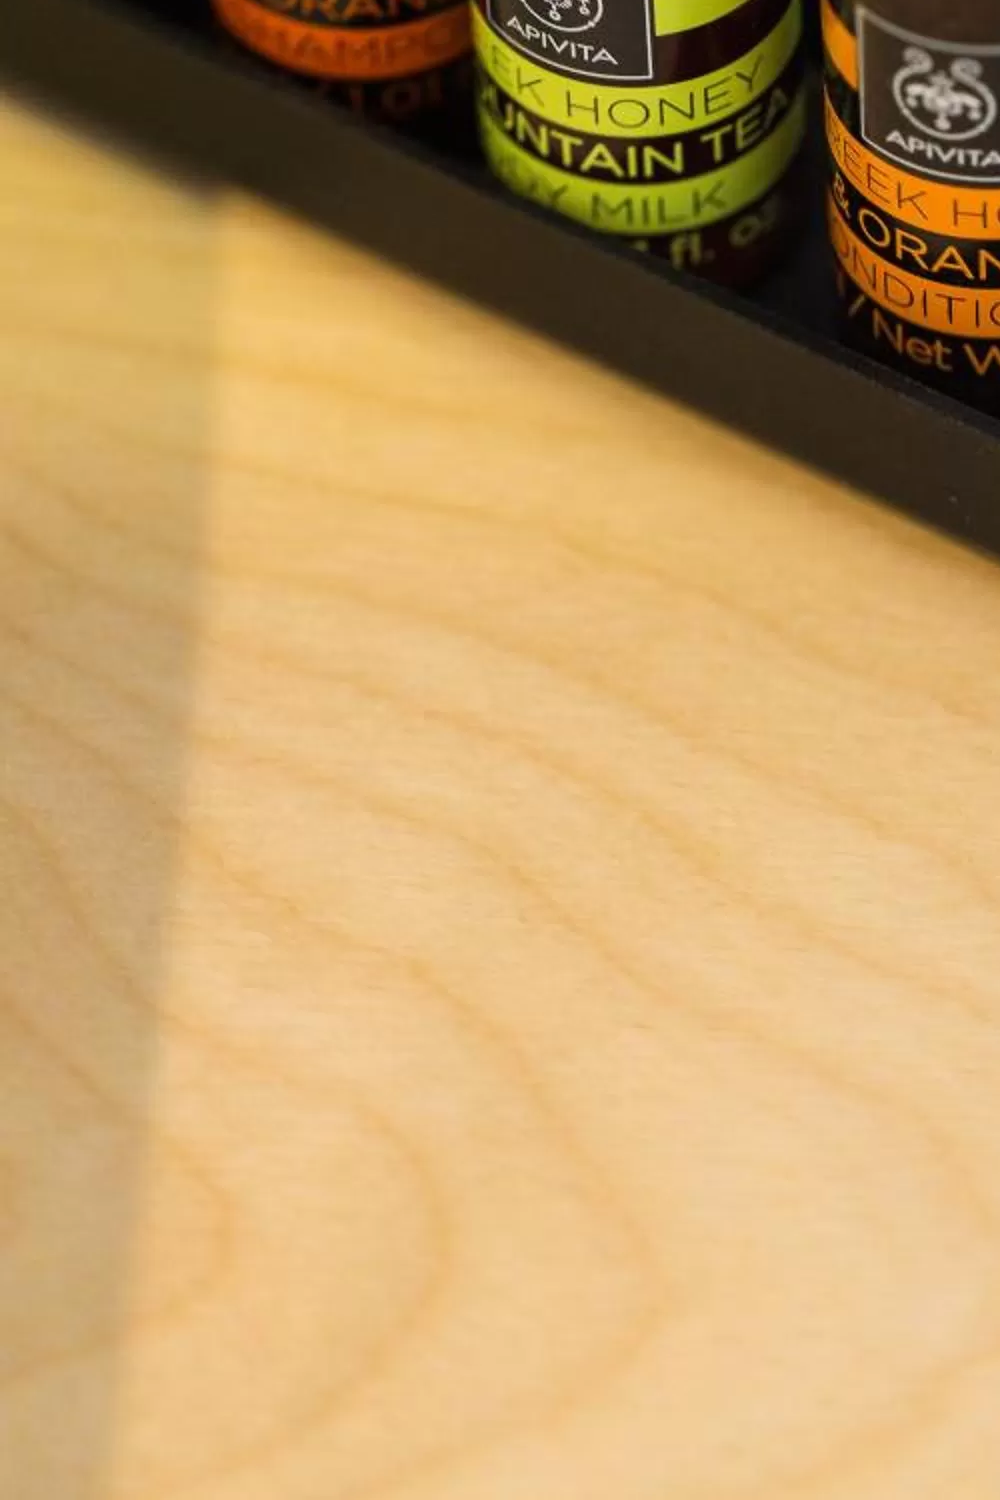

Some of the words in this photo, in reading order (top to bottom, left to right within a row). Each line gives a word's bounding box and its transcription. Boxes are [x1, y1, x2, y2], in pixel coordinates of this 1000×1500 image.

[506, 14, 619, 66] APIVITA
[564, 54, 768, 130] HONEY
[701, 88, 789, 164] TEA
[591, 179, 729, 227] MILK
[871, 307, 953, 373] Net
